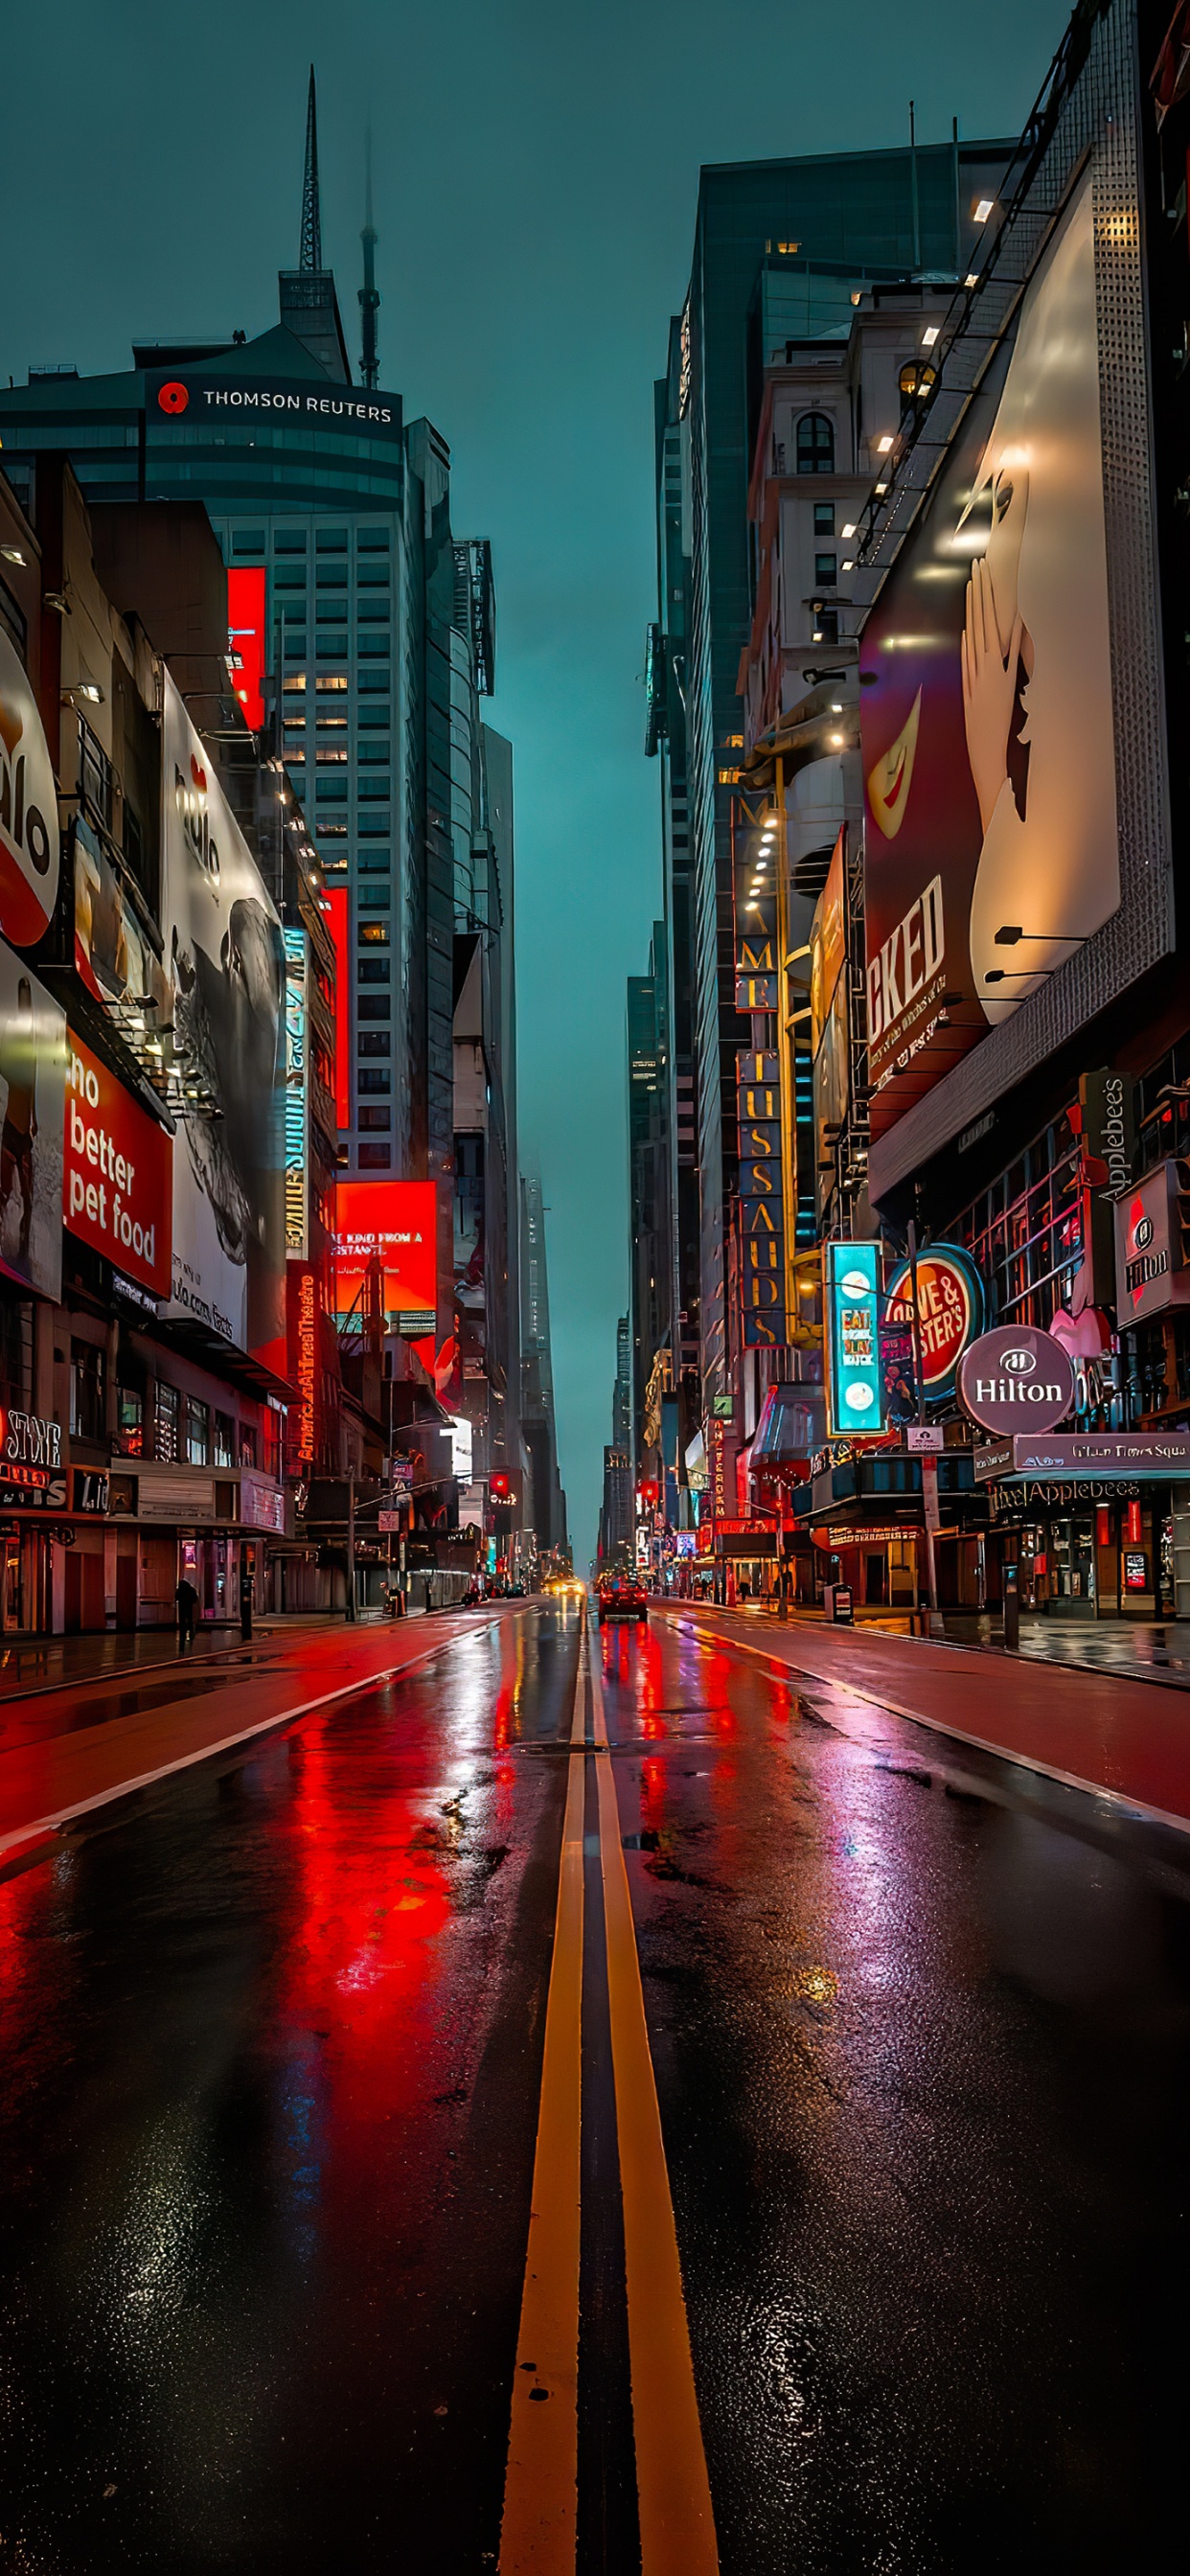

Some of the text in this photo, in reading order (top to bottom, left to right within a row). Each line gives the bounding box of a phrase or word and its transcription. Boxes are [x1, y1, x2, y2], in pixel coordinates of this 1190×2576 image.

[203, 390, 392, 423] THOMSON REUTERS
[70, 1053, 100, 1108] no
[70, 1099, 135, 1195] better
[69, 1168, 155, 1267] pet food
[744, 1052, 780, 1346] TUSSAUDS
[975, 1378, 1063, 1403] Hilton
